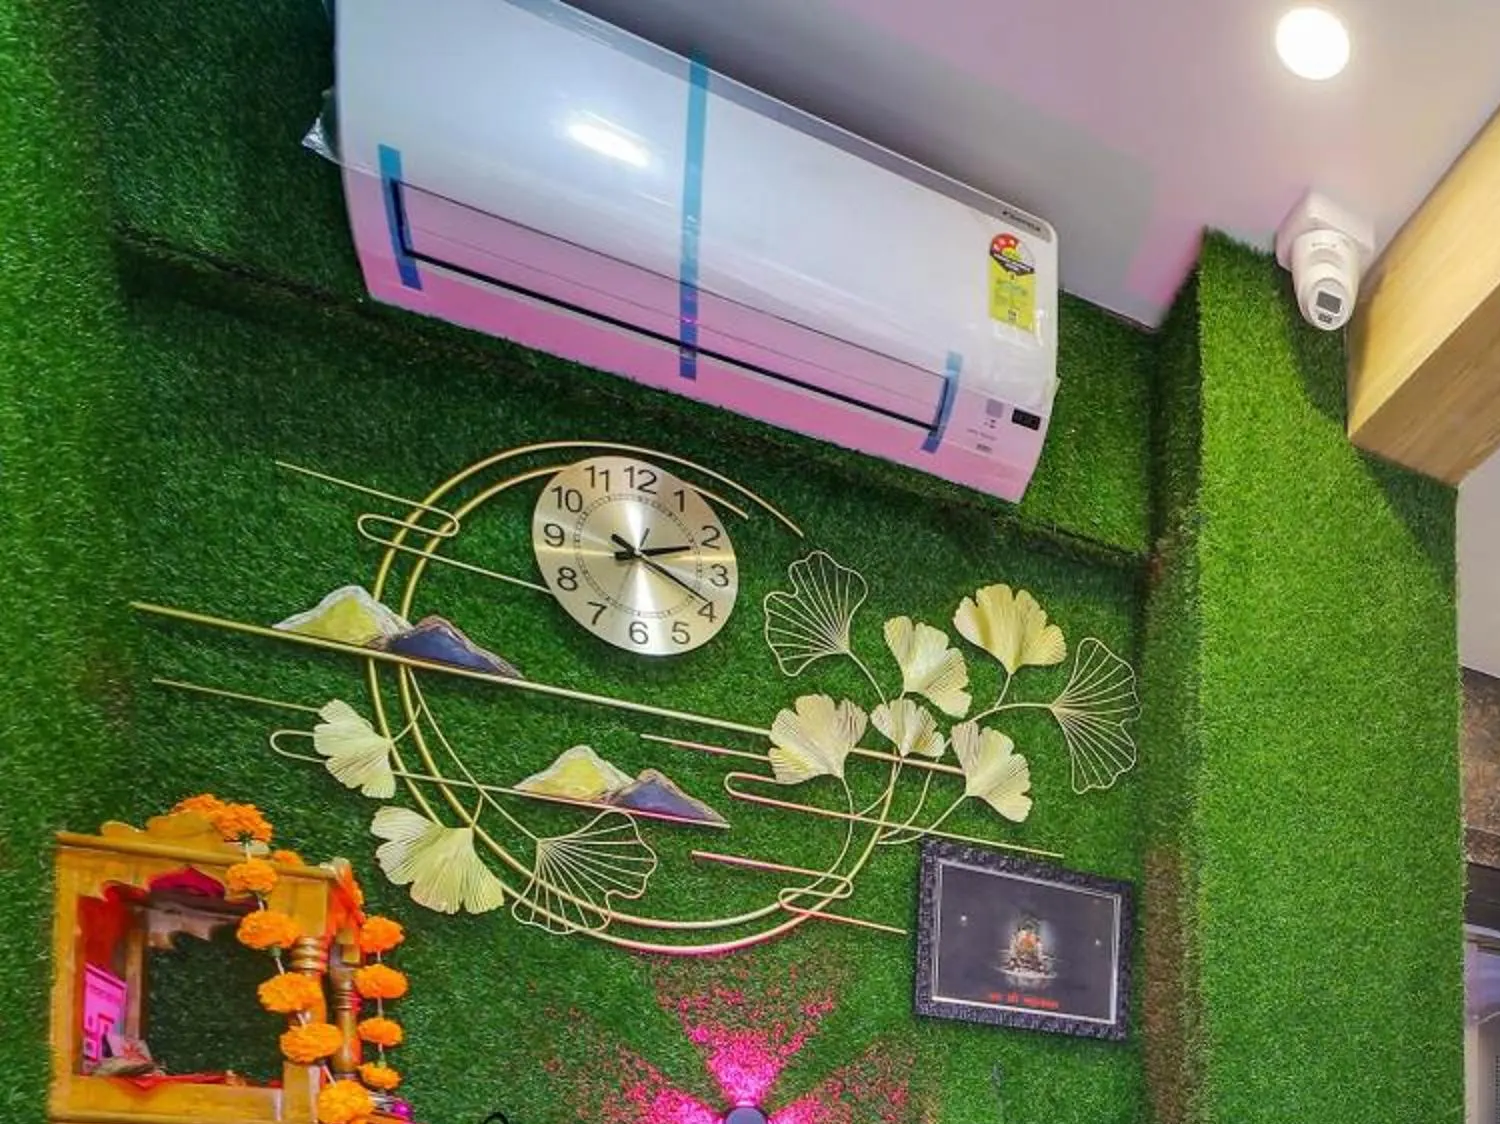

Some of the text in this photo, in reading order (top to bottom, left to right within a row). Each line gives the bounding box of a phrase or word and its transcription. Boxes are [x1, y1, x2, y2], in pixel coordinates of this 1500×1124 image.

[584, 465, 610, 492] 11
[624, 466, 657, 494] 12
[551, 486, 583, 513] 10
[673, 489, 686, 512] 1
[543, 523, 565, 547] 9
[701, 525, 721, 550] 2
[557, 566, 578, 591] 8
[710, 564, 729, 587] 3
[587, 601, 607, 625] 7
[697, 601, 717, 623] 4
[629, 621, 649, 645] 6
[671, 621, 691, 645] 5
